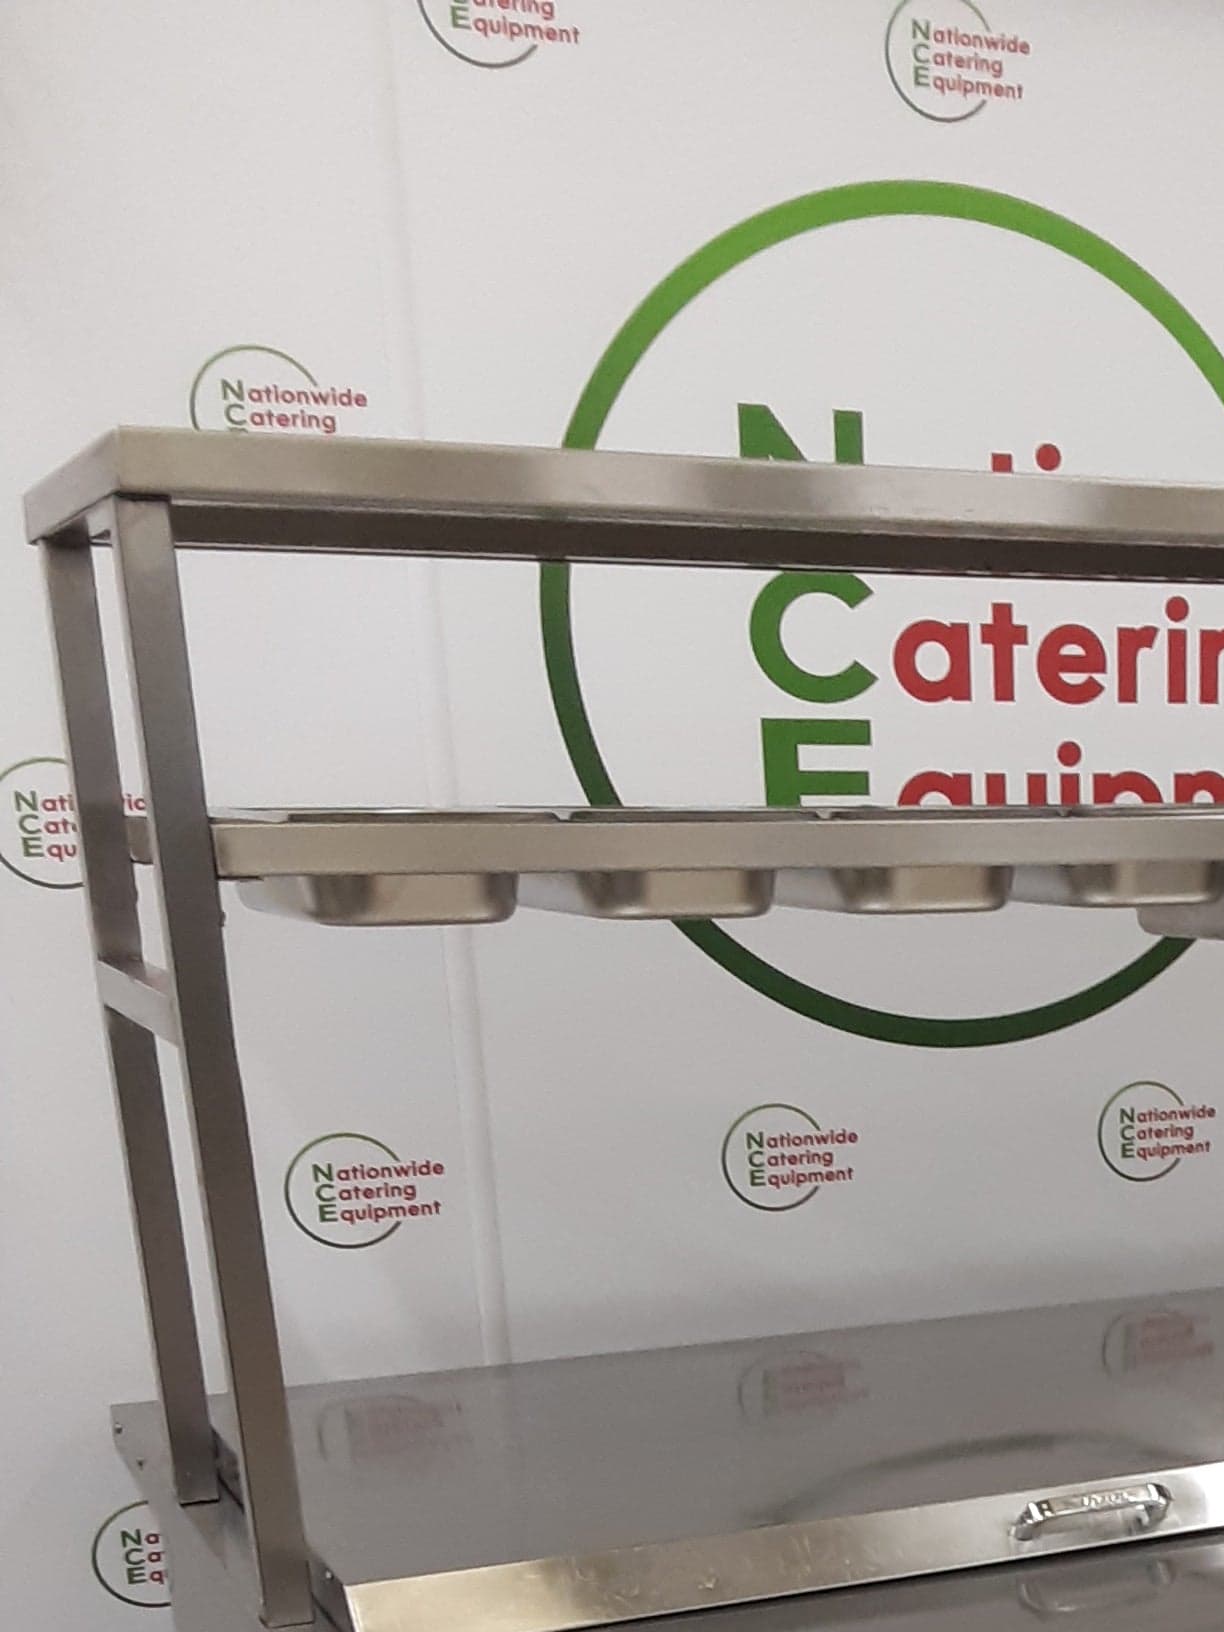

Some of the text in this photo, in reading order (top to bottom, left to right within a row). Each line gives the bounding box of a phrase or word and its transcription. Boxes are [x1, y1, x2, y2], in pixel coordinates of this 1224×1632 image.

[451, 5, 580, 44] Equipment
[911, 19, 1030, 55] Nationwide
[912, 43, 1003, 77] Catering
[914, 66, 1023, 99] Equipment
[221, 378, 367, 408] Nationwide
[225, 403, 337, 433] Catering
[1120, 1105, 1216, 1125] Nationwide
[746, 1128, 858, 1150] Nationwide
[1120, 1124, 1194, 1141] Catering
[748, 1149, 833, 1168] Catering
[1121, 1140, 1211, 1159] Equipment
[312, 1160, 444, 1183] Nationwide
[749, 1167, 853, 1189] Equipment
[315, 1182, 416, 1202] Catering
[319, 1201, 441, 1223] Equipment
